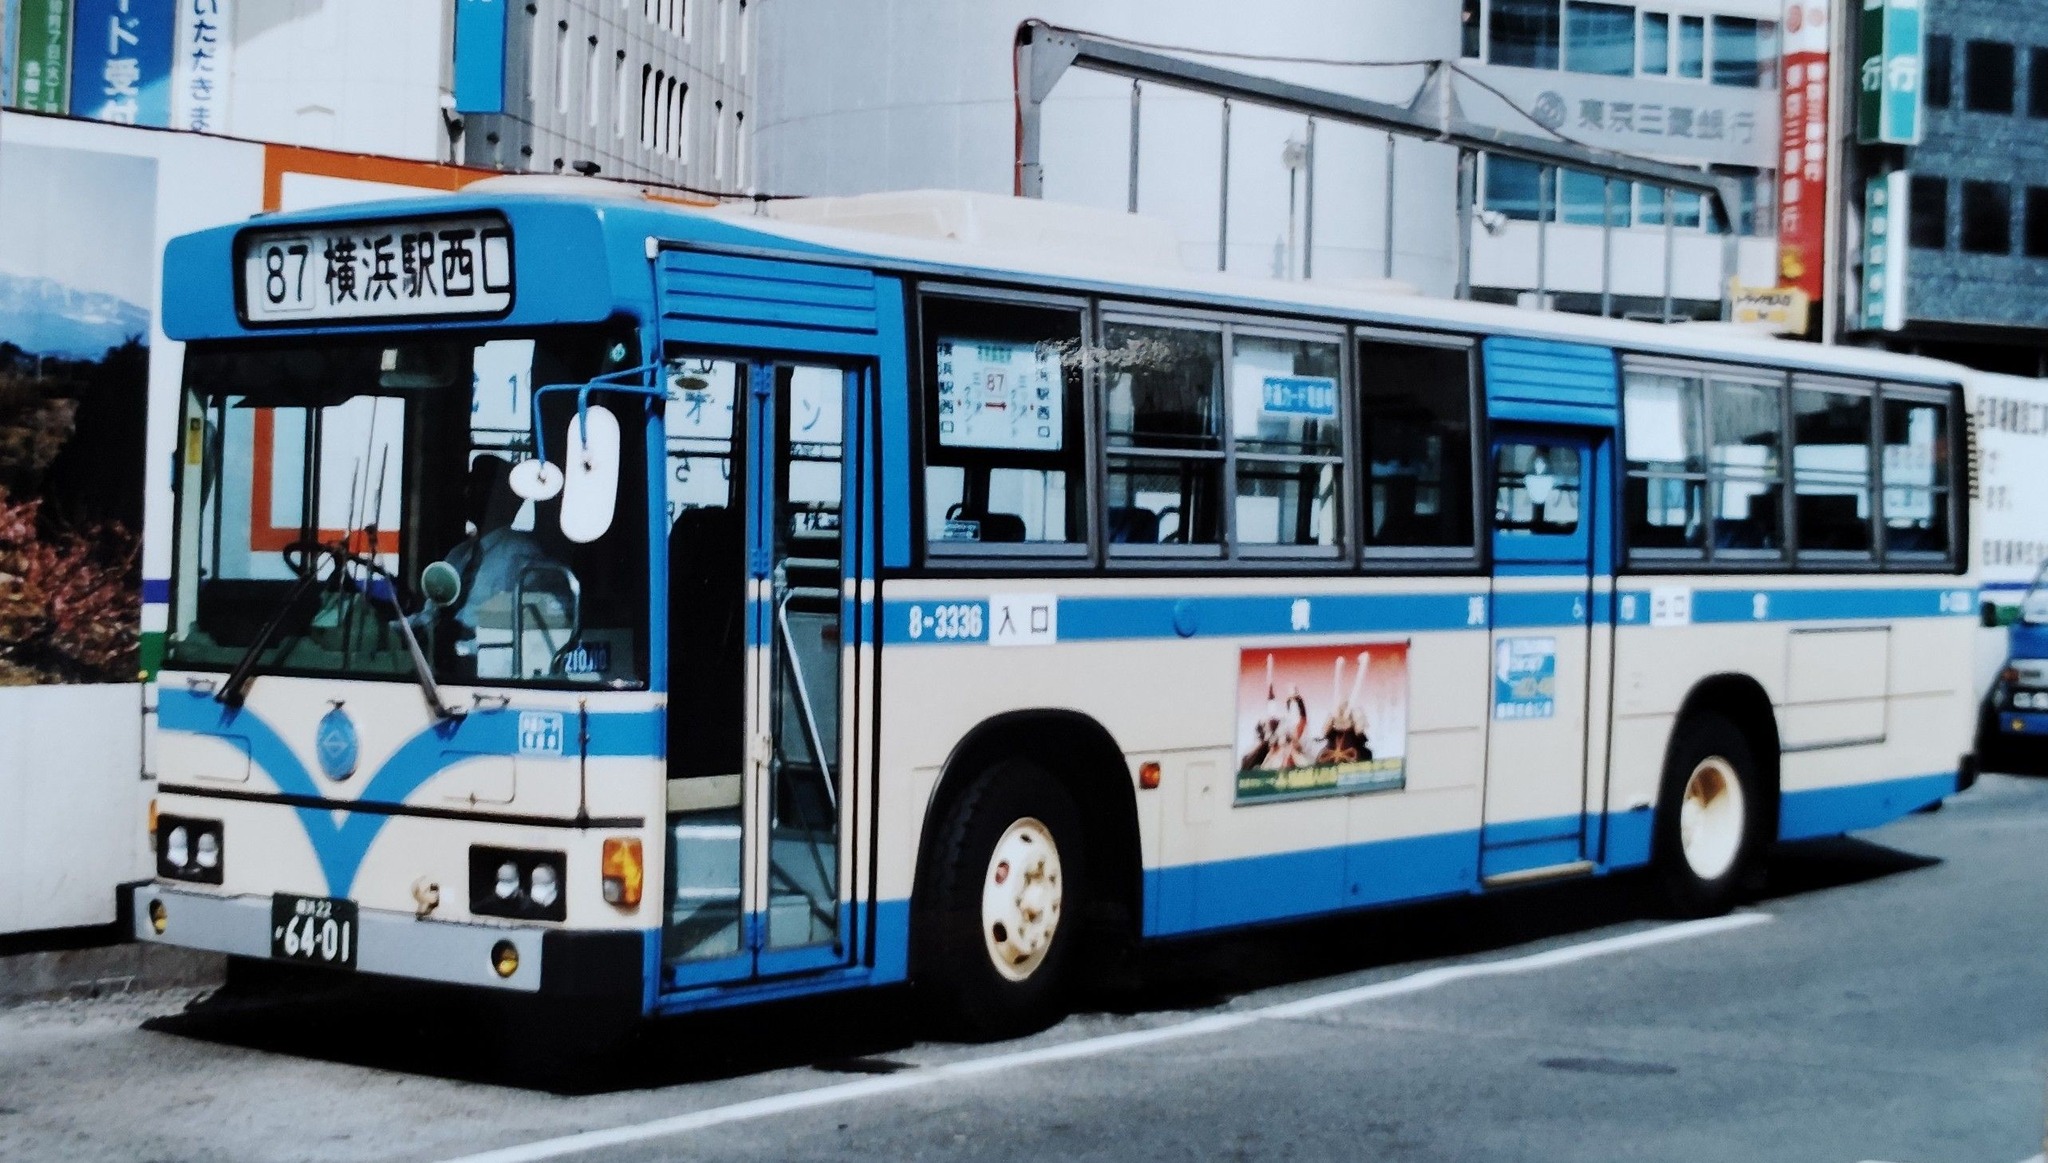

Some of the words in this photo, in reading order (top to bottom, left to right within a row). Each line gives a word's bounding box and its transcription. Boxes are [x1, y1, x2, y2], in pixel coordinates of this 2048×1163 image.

[1577, 99, 1755, 145] 東京三菱銀行
[266, 245, 309, 304] 87
[324, 227, 511, 306] 横浜駅西口
[986, 373, 1005, 392] 87
